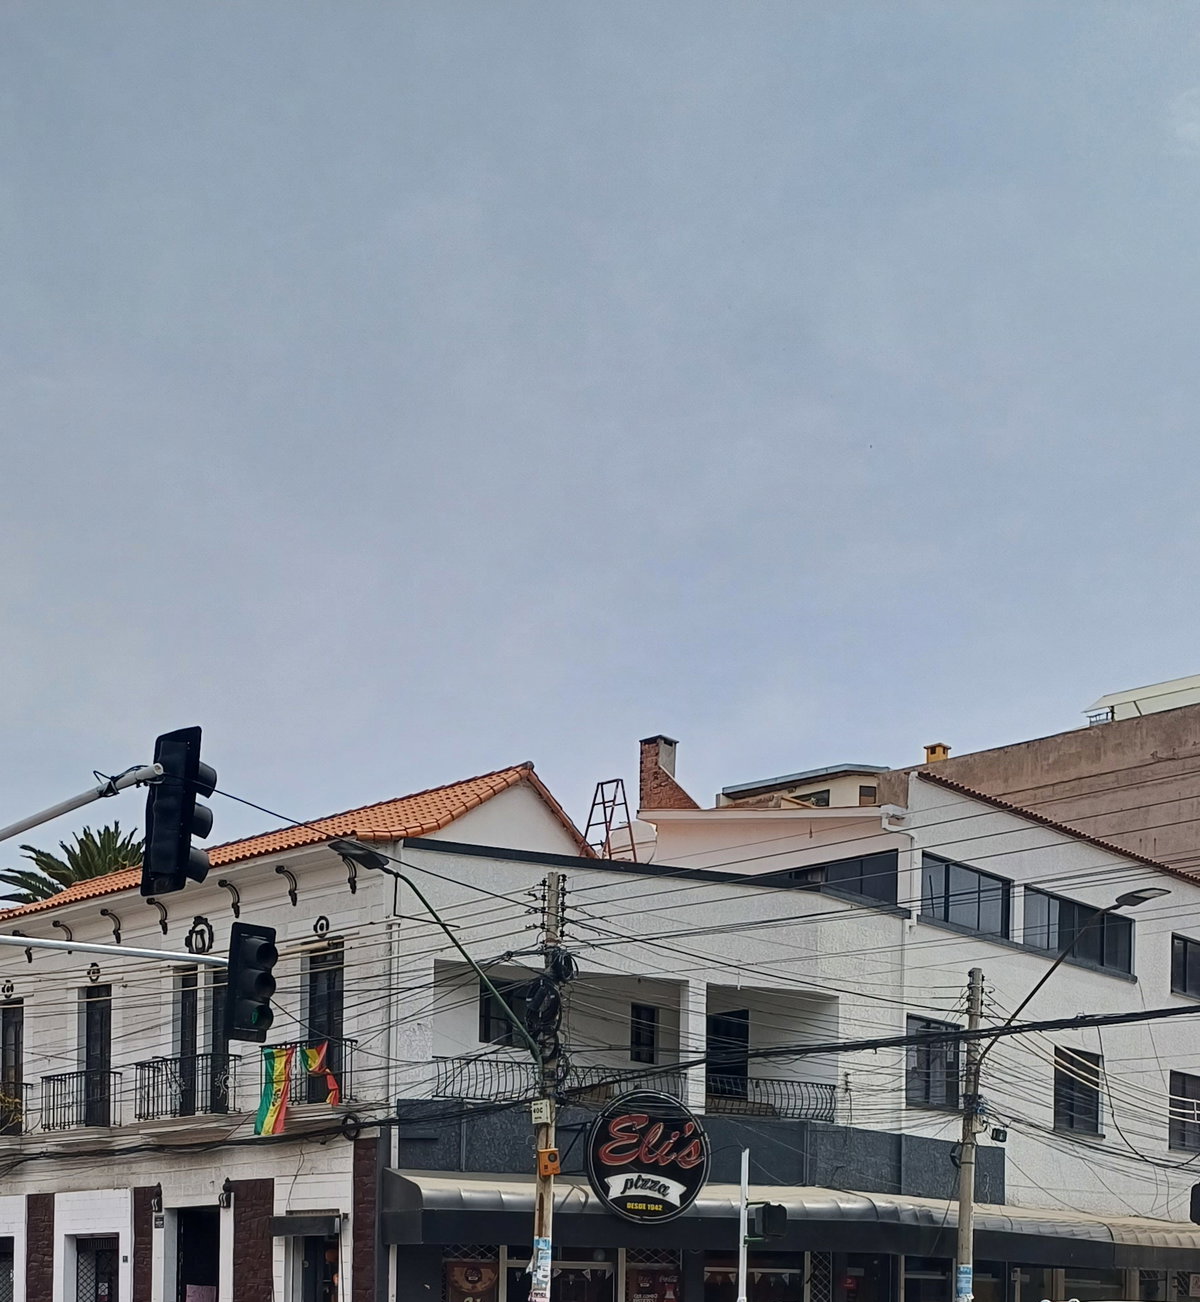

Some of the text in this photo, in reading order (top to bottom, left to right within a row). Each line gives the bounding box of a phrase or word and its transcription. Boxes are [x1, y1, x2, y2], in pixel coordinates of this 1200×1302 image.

[599, 1113, 704, 1169] Eli's
[620, 1174, 671, 1198] pizza
[626, 1202, 663, 1211] DESDE 1942
